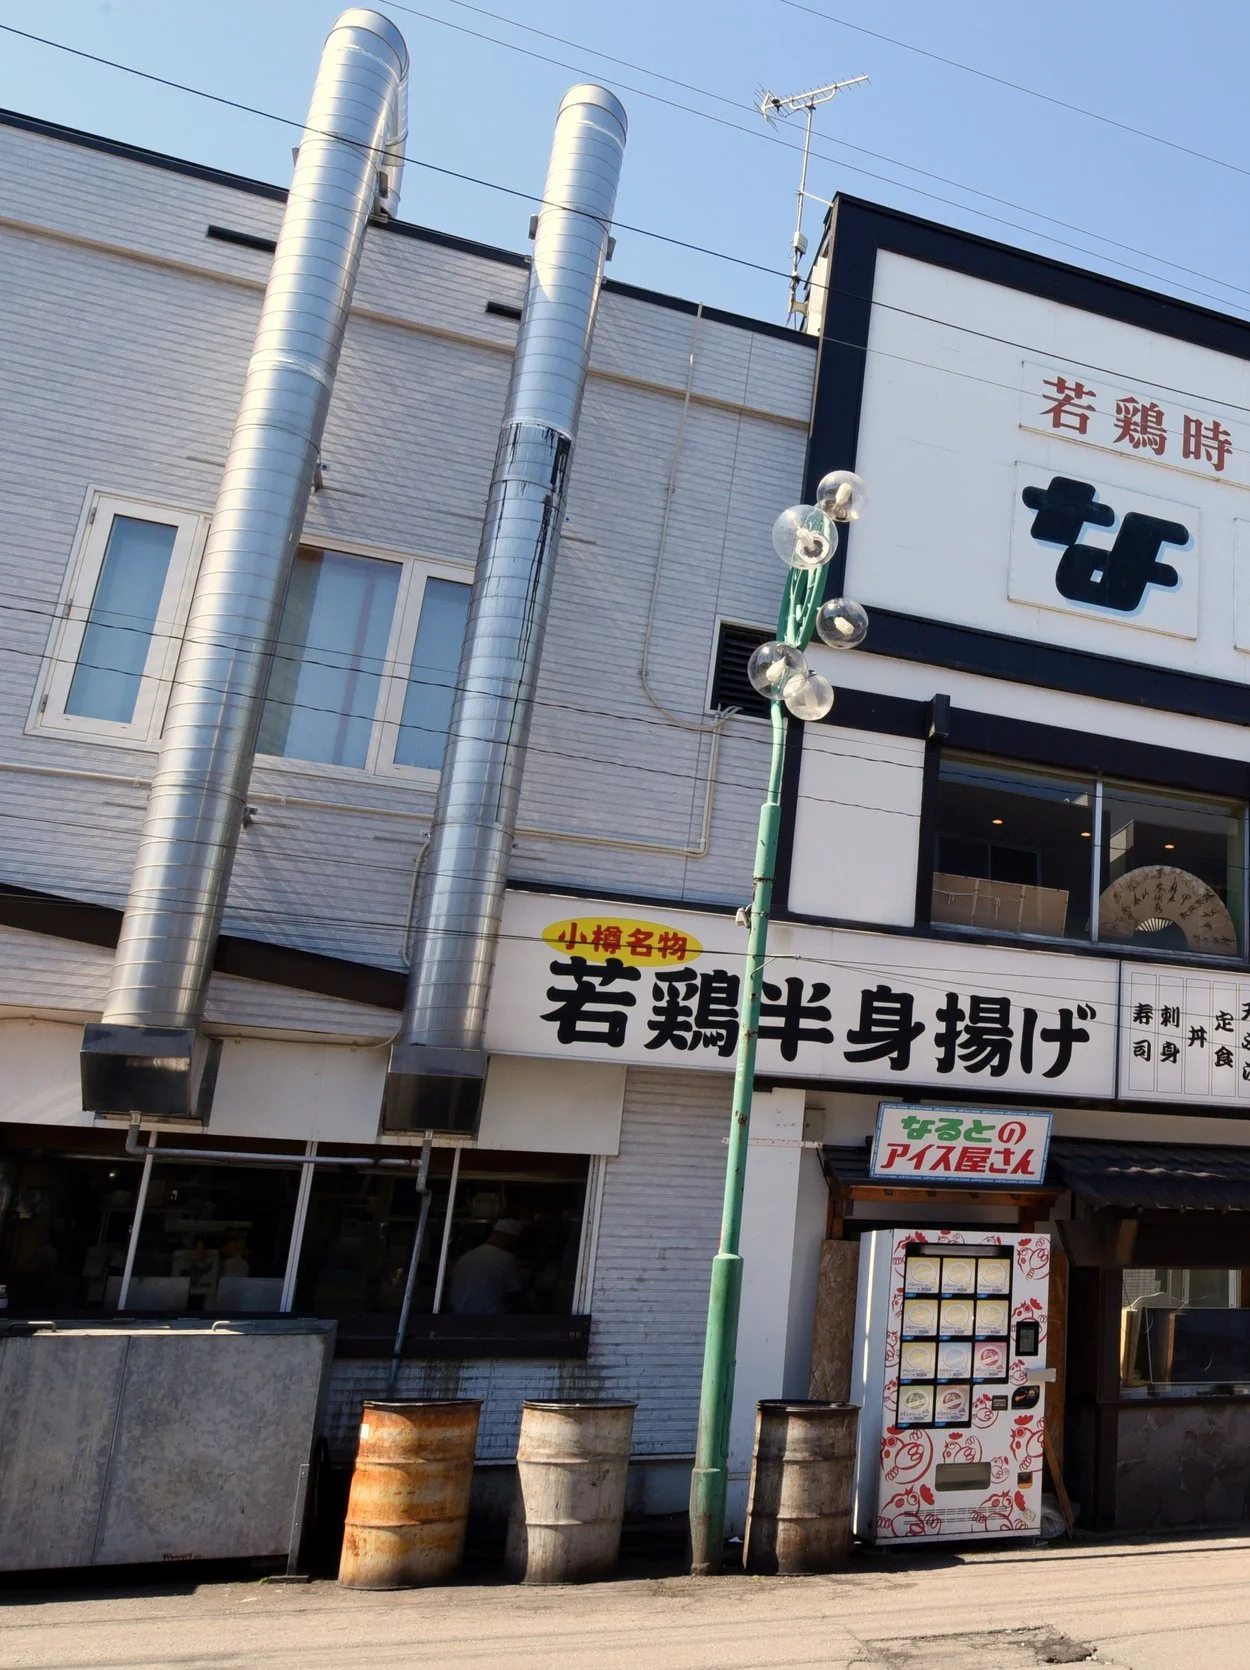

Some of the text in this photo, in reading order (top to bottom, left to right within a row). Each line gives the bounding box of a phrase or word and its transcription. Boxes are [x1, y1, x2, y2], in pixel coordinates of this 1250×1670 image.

[558, 921, 688, 962] 小樽名物
[539, 955, 1098, 1079] 若鶏半身揚げ
[1132, 1003, 1154, 1063] 寿司
[1160, 1005, 1180, 1064] 刺身
[1188, 1025, 1208, 1049] 丼
[1214, 1010, 1235, 1068] 定食
[901, 1115, 1027, 1145] なるとの
[880, 1143, 1036, 1175] アイス屋さん
